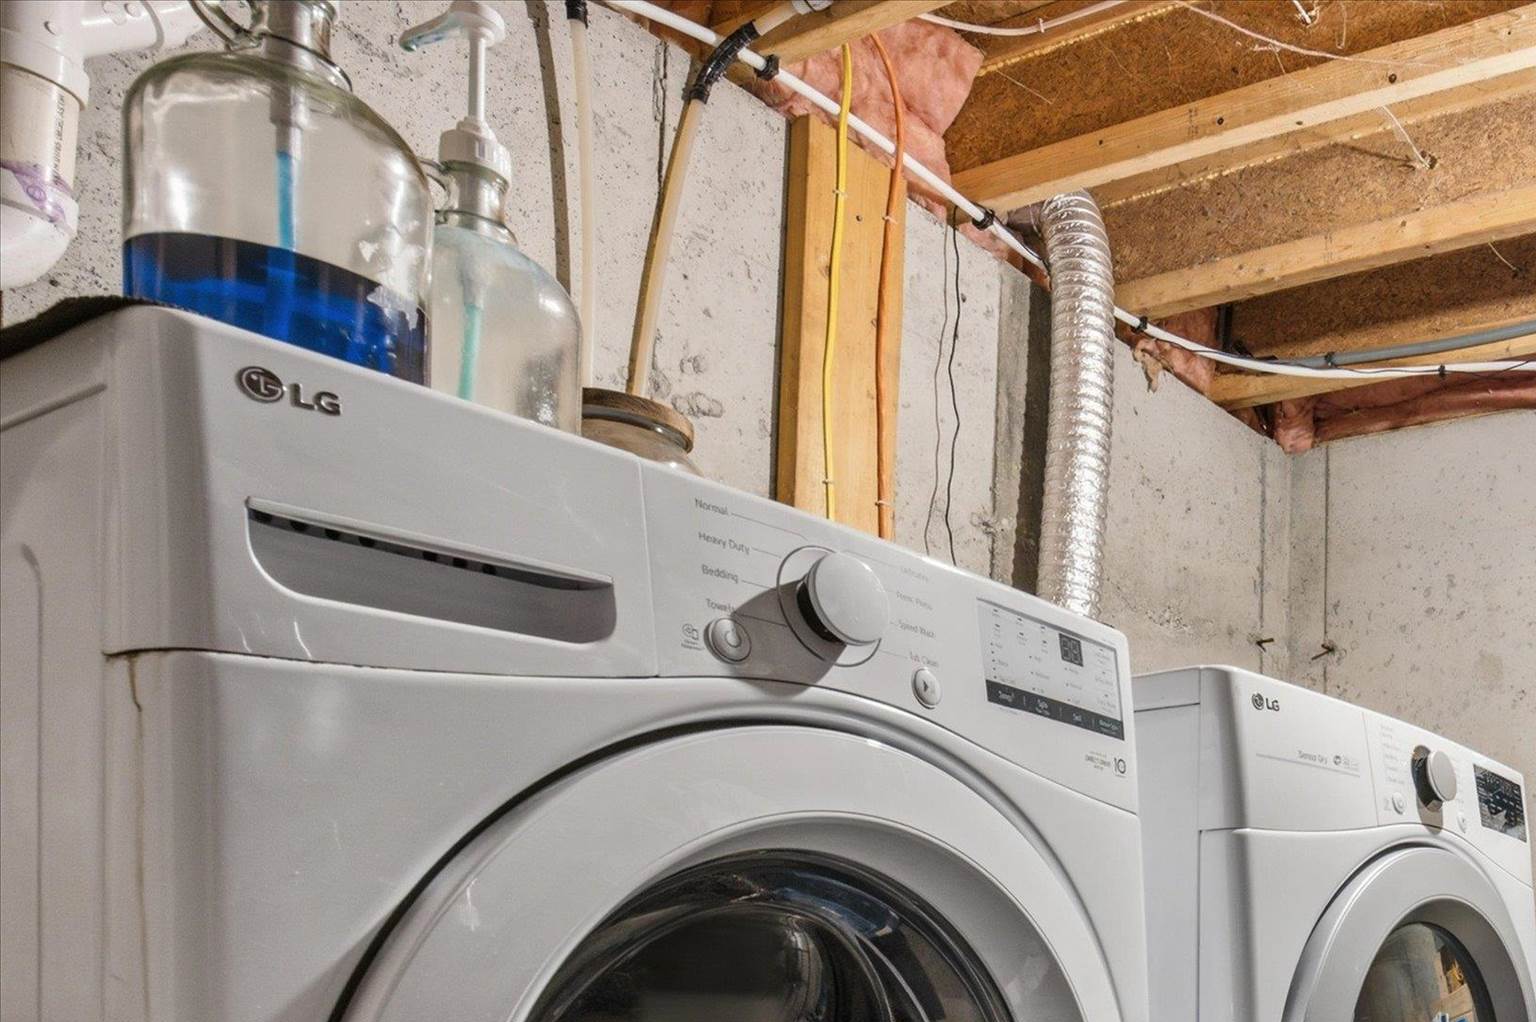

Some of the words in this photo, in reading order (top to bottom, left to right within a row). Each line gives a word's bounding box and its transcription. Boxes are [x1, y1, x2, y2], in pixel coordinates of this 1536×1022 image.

[288, 382, 342, 417] LG
[694, 498, 729, 516] Normal
[698, 531, 727, 549] Heavy
[728, 538, 751, 555] Duty
[702, 564, 739, 584] Bedding
[1265, 698, 1280, 712] LG
